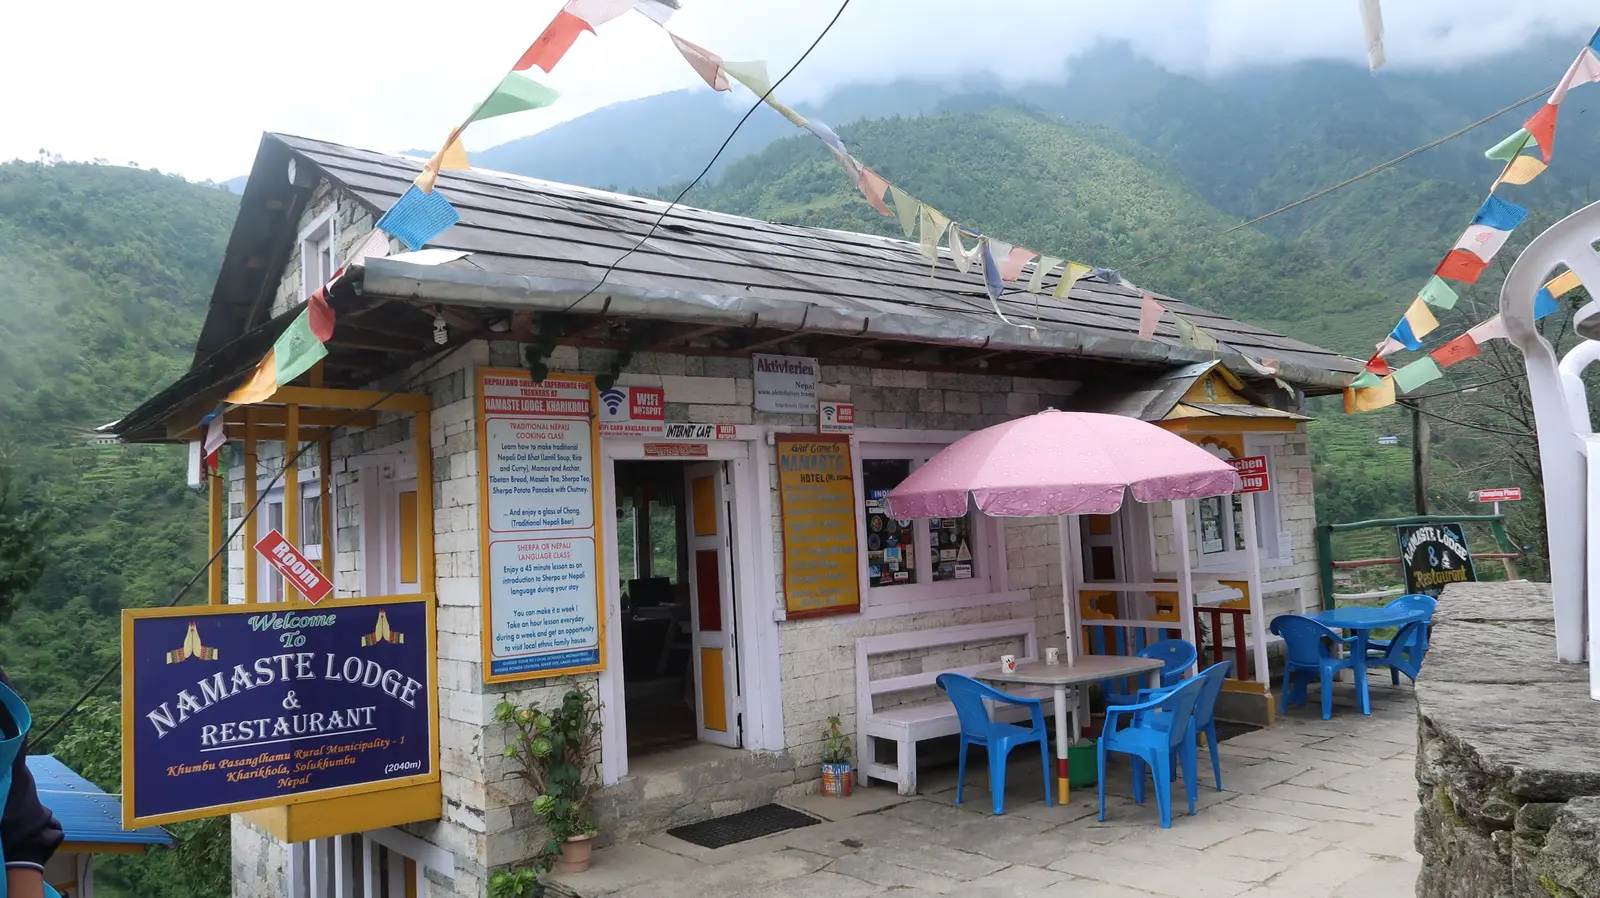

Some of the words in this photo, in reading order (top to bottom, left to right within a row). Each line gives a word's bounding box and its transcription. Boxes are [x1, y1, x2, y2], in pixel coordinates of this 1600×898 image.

[757, 358, 814, 375] Aktivferien
[485, 378, 505, 386] NEPALI
[544, 381, 577, 389] EXPERIENCE
[578, 382, 588, 390] FOR
[795, 381, 815, 390] Nepal
[520, 389, 549, 397] TREKKERS
[485, 399, 520, 411] NAMASTE
[521, 400, 545, 412] LODGE,
[546, 401, 589, 413] KHARIKHOLA
[634, 406, 661, 415] HOTSPOT
[666, 425, 694, 438] INTERNET
[720, 425, 734, 434] WIFI
[497, 453, 515, 462] Nepali
[557, 454, 571, 462] Soup,
[511, 476, 529, 484] Bread,
[550, 475, 560, 483] Tea,
[562, 475, 579, 483] Sherpa
[580, 475, 590, 483] Tea,
[800, 473, 825, 483] HOTEL
[493, 487, 512, 495] Sherpa
[522, 509, 536, 517] enjoy
[542, 507, 555, 516] glass
[511, 519, 541, 527] (Traditional
[543, 518, 560, 527] Nepali
[561, 517, 574, 525] Beer)
[1404, 527, 1436, 567] NAMASTE
[1436, 528, 1468, 561] LODGE
[518, 553, 551, 561] LANGUAGE
[1427, 545, 1439, 567] &
[503, 565, 518, 574] Enjoy
[525, 564, 532, 572] 45
[533, 563, 551, 571] minute
[502, 576, 534, 584] introduction
[542, 574, 560, 583] Sherpa
[568, 571, 585, 581] Nepali
[1413, 564, 1468, 589] Restaurant
[511, 587, 536, 596] language
[537, 585, 554, 593] during
[555, 585, 567, 593] your
[568, 583, 579, 592] stay
[536, 607, 550, 615] make
[561, 604, 575, 612] week
[247, 611, 337, 632] Welcome
[507, 621, 520, 629] Take
[530, 619, 542, 627] hour
[543, 618, 559, 626] lesson
[561, 615, 585, 625] everyday
[279, 630, 306, 649] To
[496, 633, 514, 641] during
[521, 631, 536, 639] week
[566, 625, 594, 634] opportunity
[524, 642, 536, 650] local
[538, 640, 553, 648] ethnic
[554, 638, 570, 647] family
[146, 652, 317, 738] NAMASTE
[324, 652, 423, 709] LODGE
[281, 689, 302, 710] &
[200, 705, 377, 747] RESTAURANT
[166, 760, 216, 778] Khumbu
[218, 751, 291, 770] Pasanglhamu
[294, 746, 324, 759] Rural
[326, 736, 391, 755] Municipality
[399, 735, 406, 745] 1
[226, 764, 290, 783] Kharikhola,
[293, 756, 356, 774] Solukhumbu
[384, 760, 422, 775] (2040m)
[277, 774, 310, 789] Nepal
